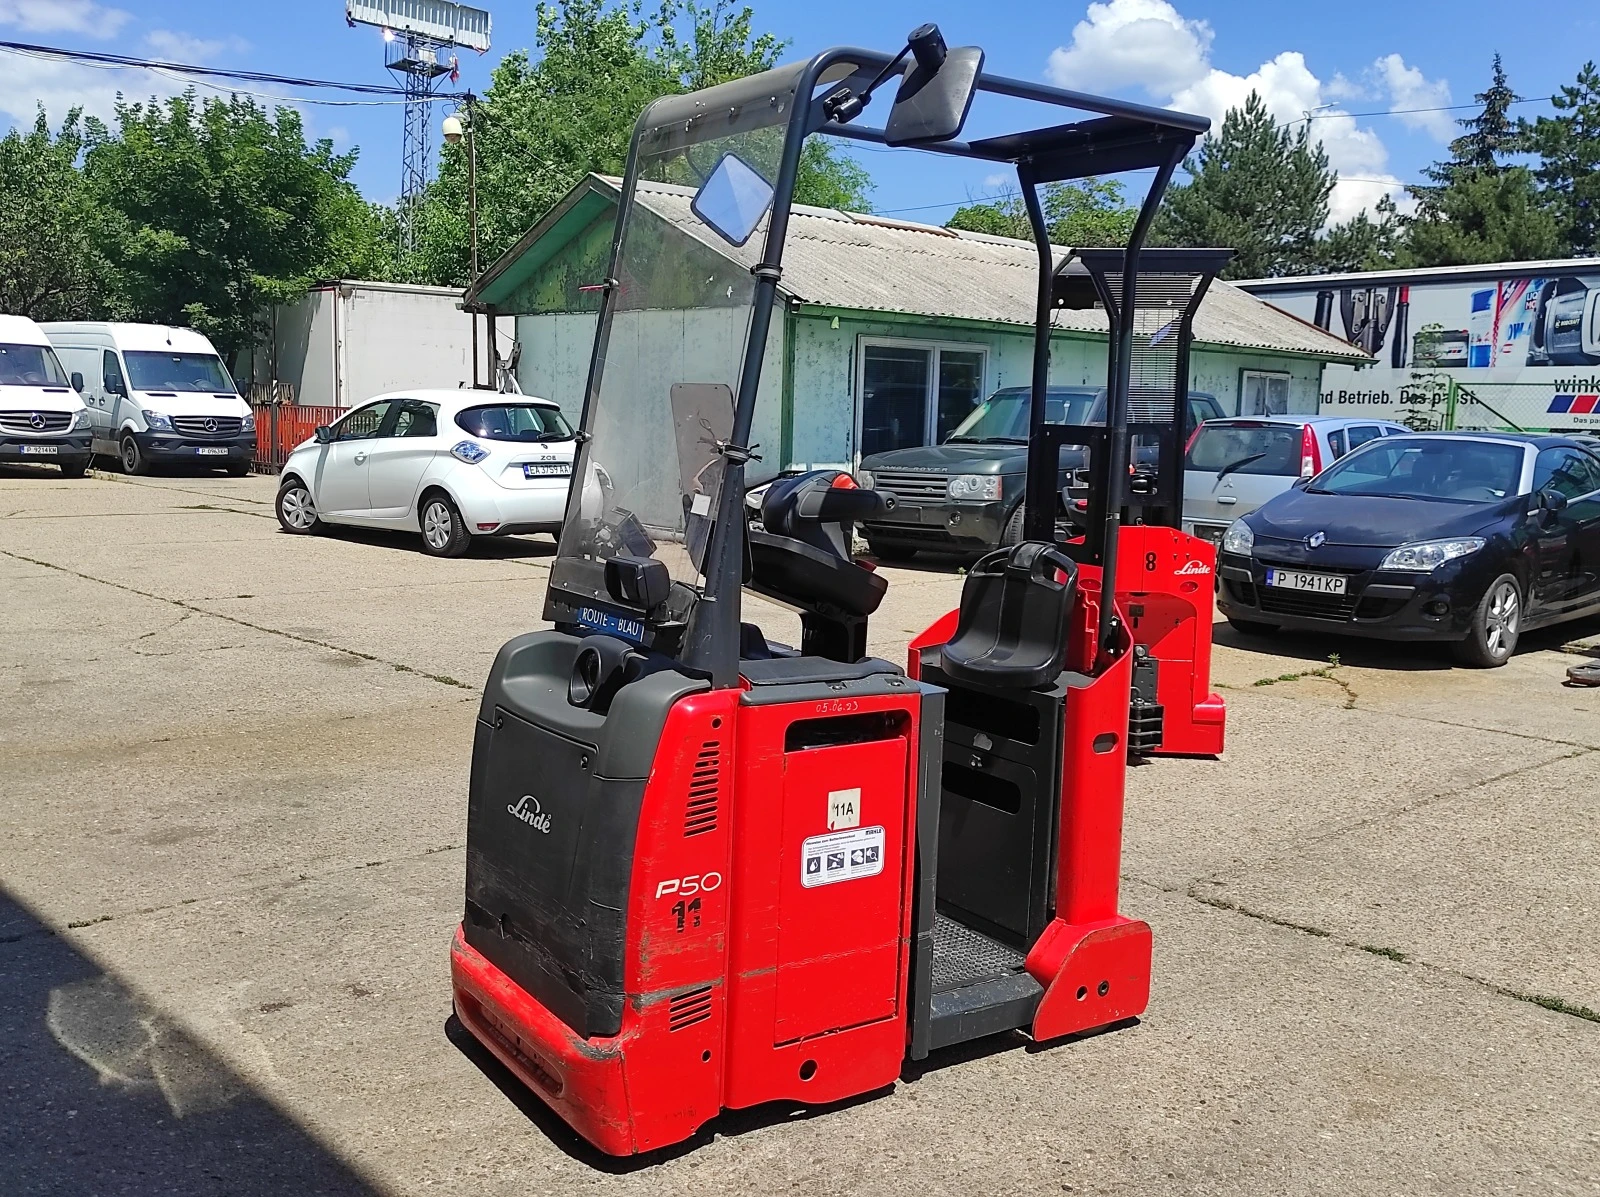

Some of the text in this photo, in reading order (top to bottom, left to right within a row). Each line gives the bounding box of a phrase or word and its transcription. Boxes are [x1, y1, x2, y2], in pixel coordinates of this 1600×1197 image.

[1338, 390, 1394, 405] Betrieb.
[1145, 551, 1157, 571] 8
[1174, 560, 1211, 576] Linde
[1278, 572, 1287, 585] P
[581, 607, 608, 627] ROUTE
[617, 618, 639, 636] BLAU
[507, 795, 552, 834] Linde
[835, 801, 854, 817] 11A
[655, 871, 722, 899] P50
